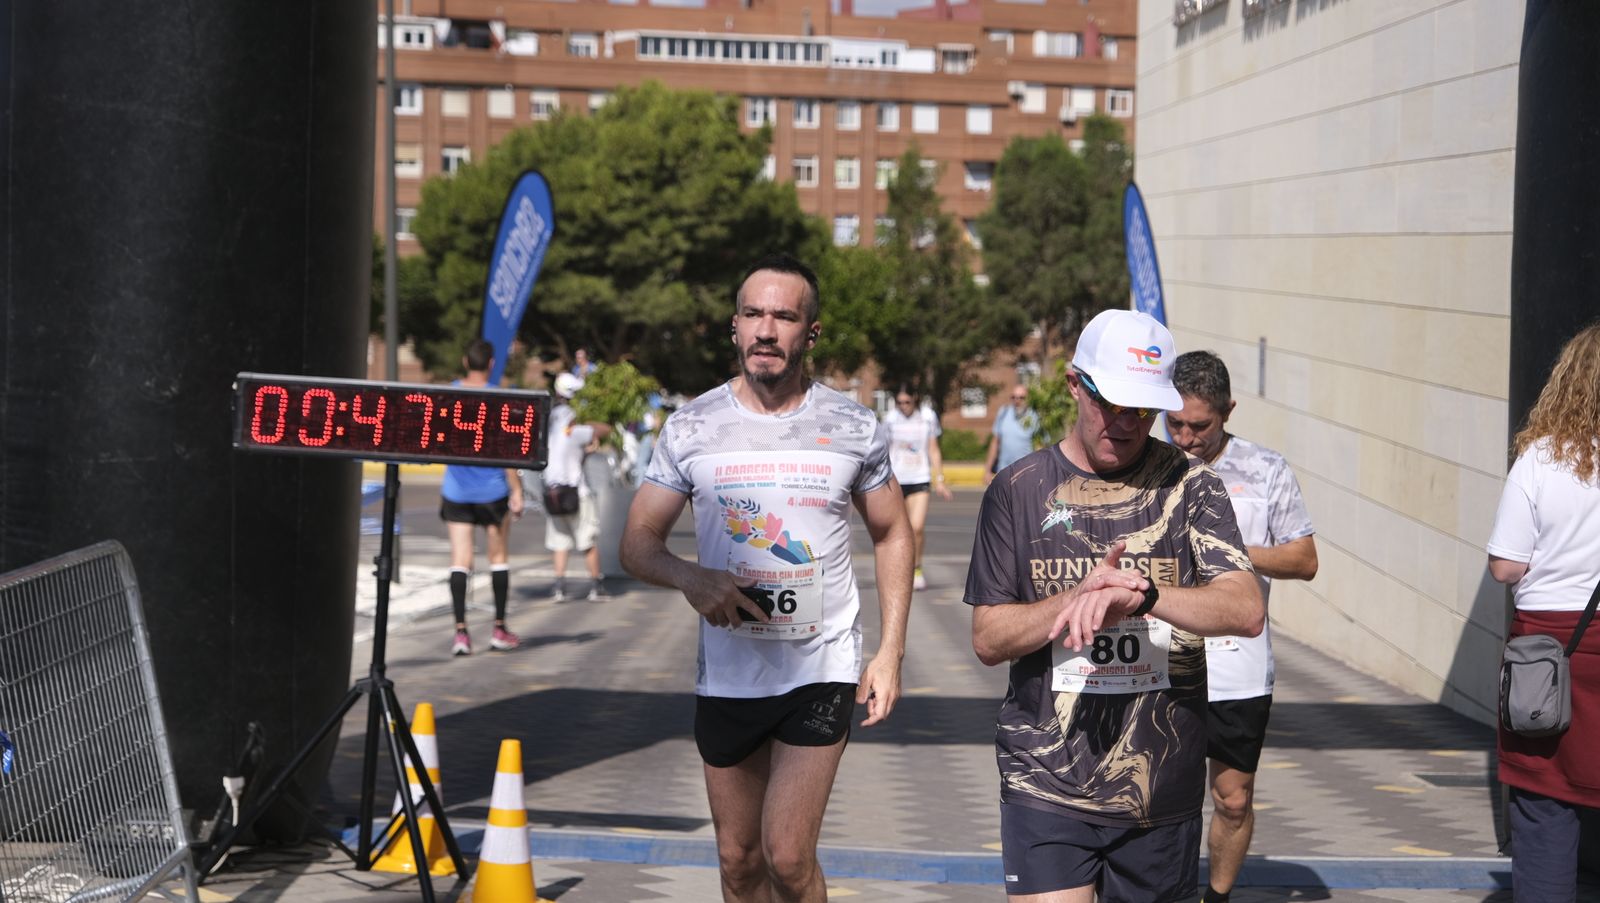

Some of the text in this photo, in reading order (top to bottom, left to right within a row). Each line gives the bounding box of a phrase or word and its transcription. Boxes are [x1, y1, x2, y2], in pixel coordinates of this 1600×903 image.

[251, 386, 535, 455] 00:47:44
[725, 464, 775, 476] CARRERA
[779, 464, 797, 473] SIN
[801, 465, 832, 476] HUMO
[787, 497, 828, 508] 4 JUNIO
[743, 568, 777, 579] CARRERA
[780, 570, 793, 580] SIN
[795, 567, 814, 579] HUMO
[1030, 557, 1150, 580] RUNNRS
[1091, 634, 1140, 665] 80
[1079, 664, 1152, 675] FRANCISCO PAULA
